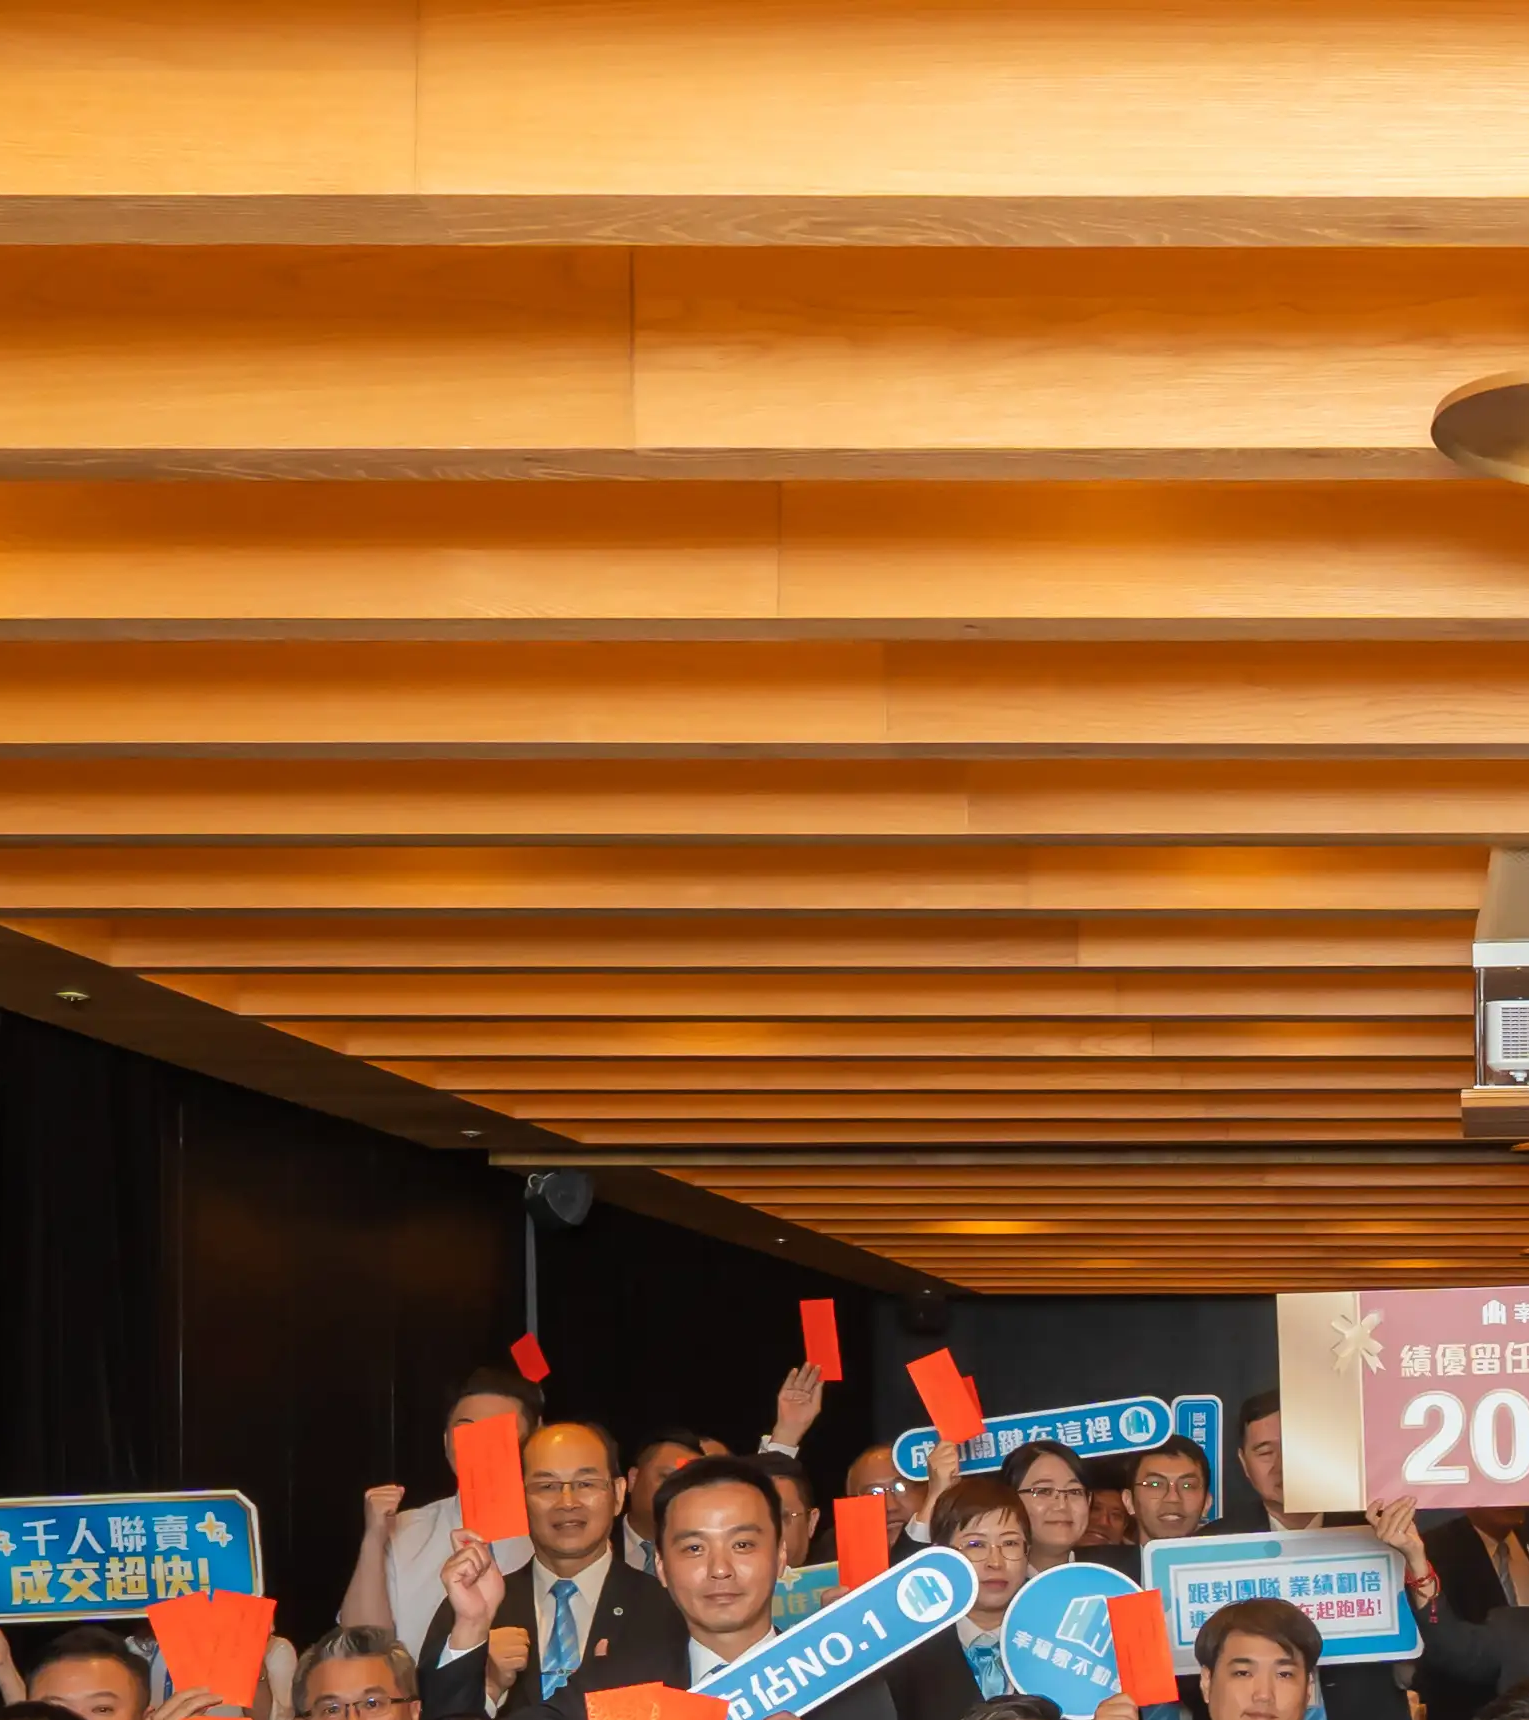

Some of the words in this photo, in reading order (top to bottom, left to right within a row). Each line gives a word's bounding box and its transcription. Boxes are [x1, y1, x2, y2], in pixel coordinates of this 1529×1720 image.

[910, 1415, 1112, 1469] 成關鍵在這裡
[21, 1514, 189, 1556] 千人聯賣
[1188, 1577, 1281, 1604] 跟對團隊
[1289, 1571, 1381, 1597] 業績翻倍
